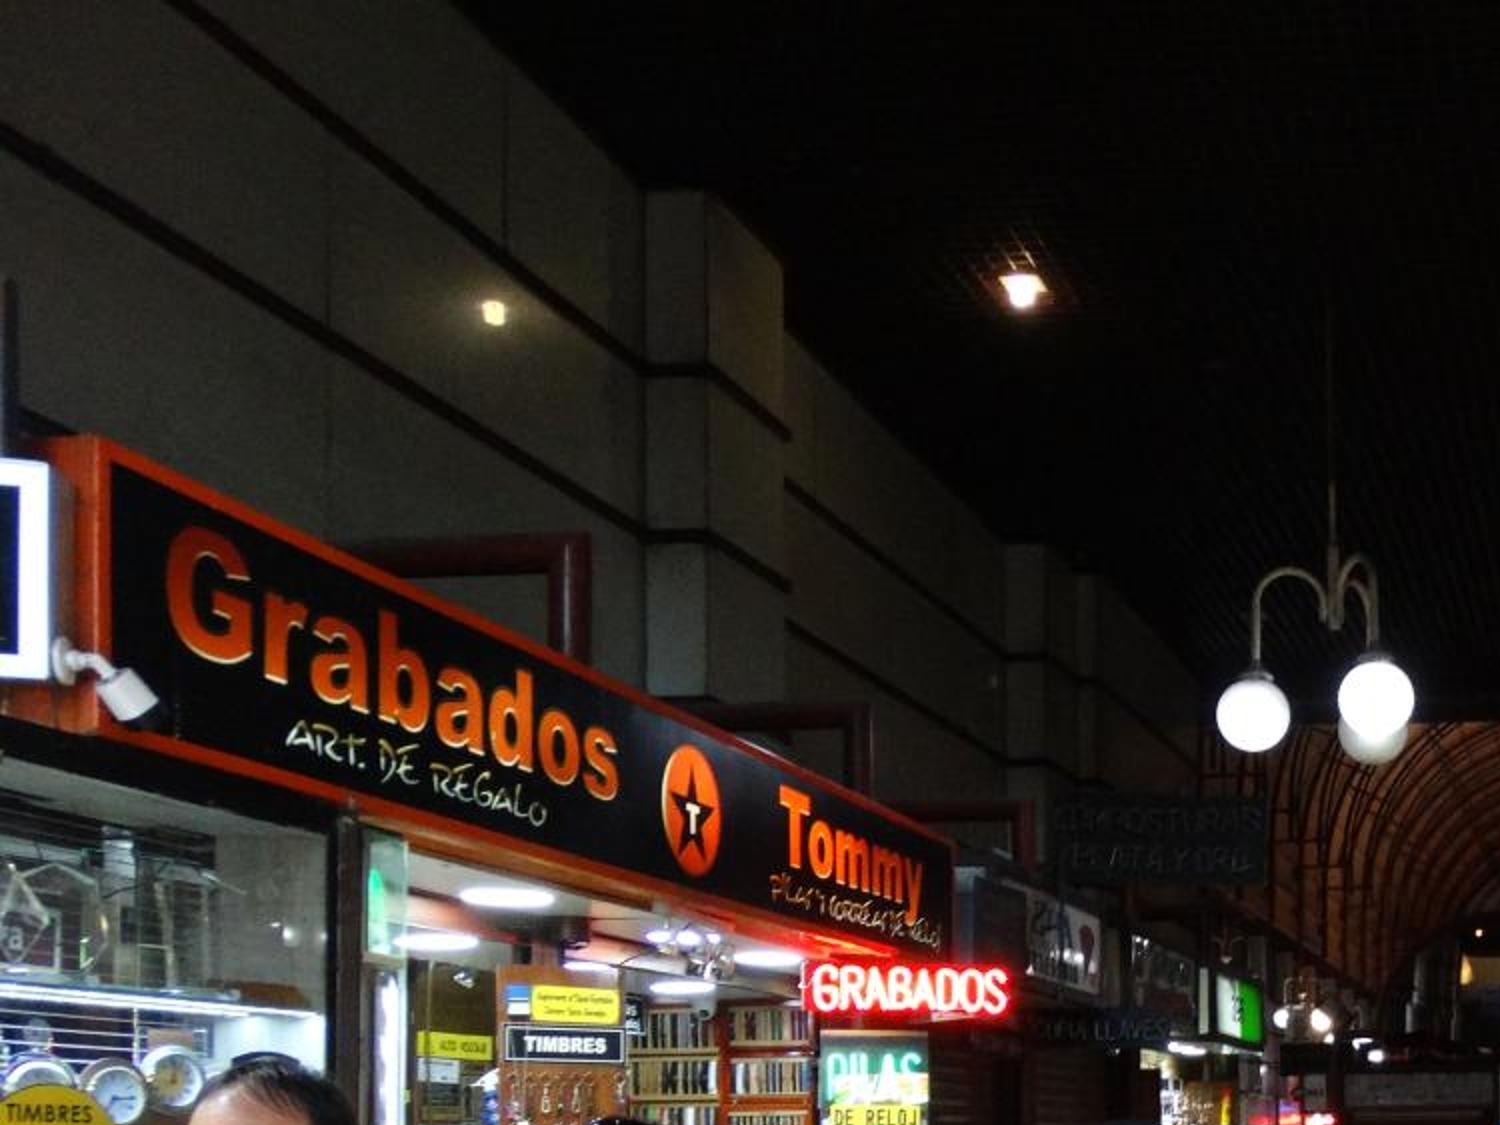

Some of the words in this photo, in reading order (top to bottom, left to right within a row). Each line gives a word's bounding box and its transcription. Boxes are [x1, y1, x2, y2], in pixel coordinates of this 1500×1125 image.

[165, 525, 619, 802] Grabados
[285, 720, 367, 770] ART.
[379, 738, 420, 786] DE
[429, 762, 548, 828] REGALO
[685, 802, 701, 835] T
[778, 784, 925, 927] Tommy
[811, 963, 1010, 1016] GRABADOS
[523, 1035, 608, 1054] TIMBRES
[826, 1051, 922, 1103] PILAS
[6, 1103, 93, 1123] TIMBRES
